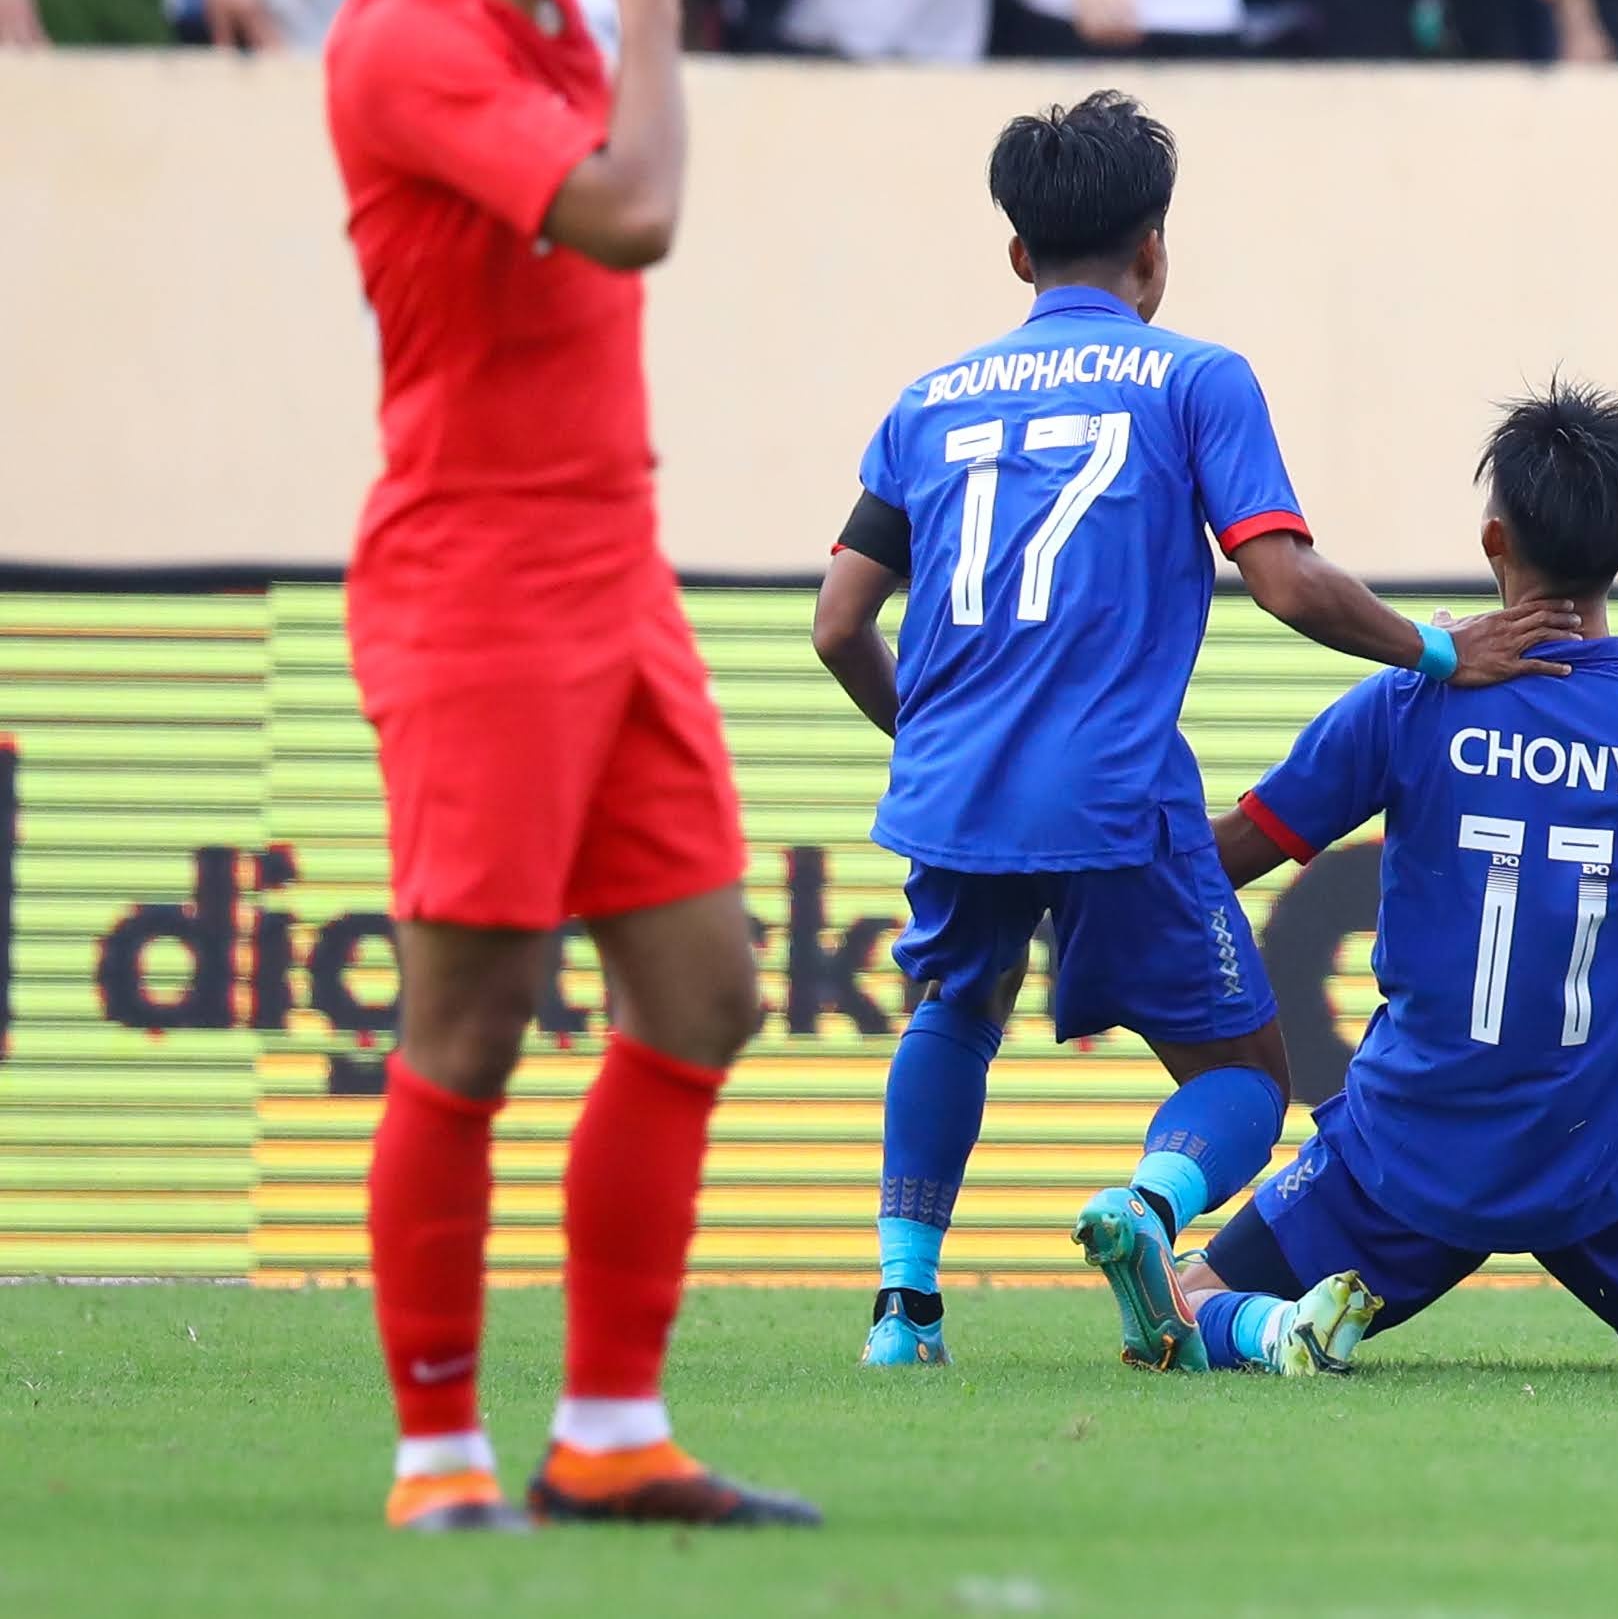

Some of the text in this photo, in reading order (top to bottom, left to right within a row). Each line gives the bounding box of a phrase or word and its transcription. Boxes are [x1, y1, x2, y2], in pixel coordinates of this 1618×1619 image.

[922, 344, 1174, 408] BOUNPHACHAN
[944, 411, 1132, 627] 17
[1457, 814, 1615, 1047] 11
